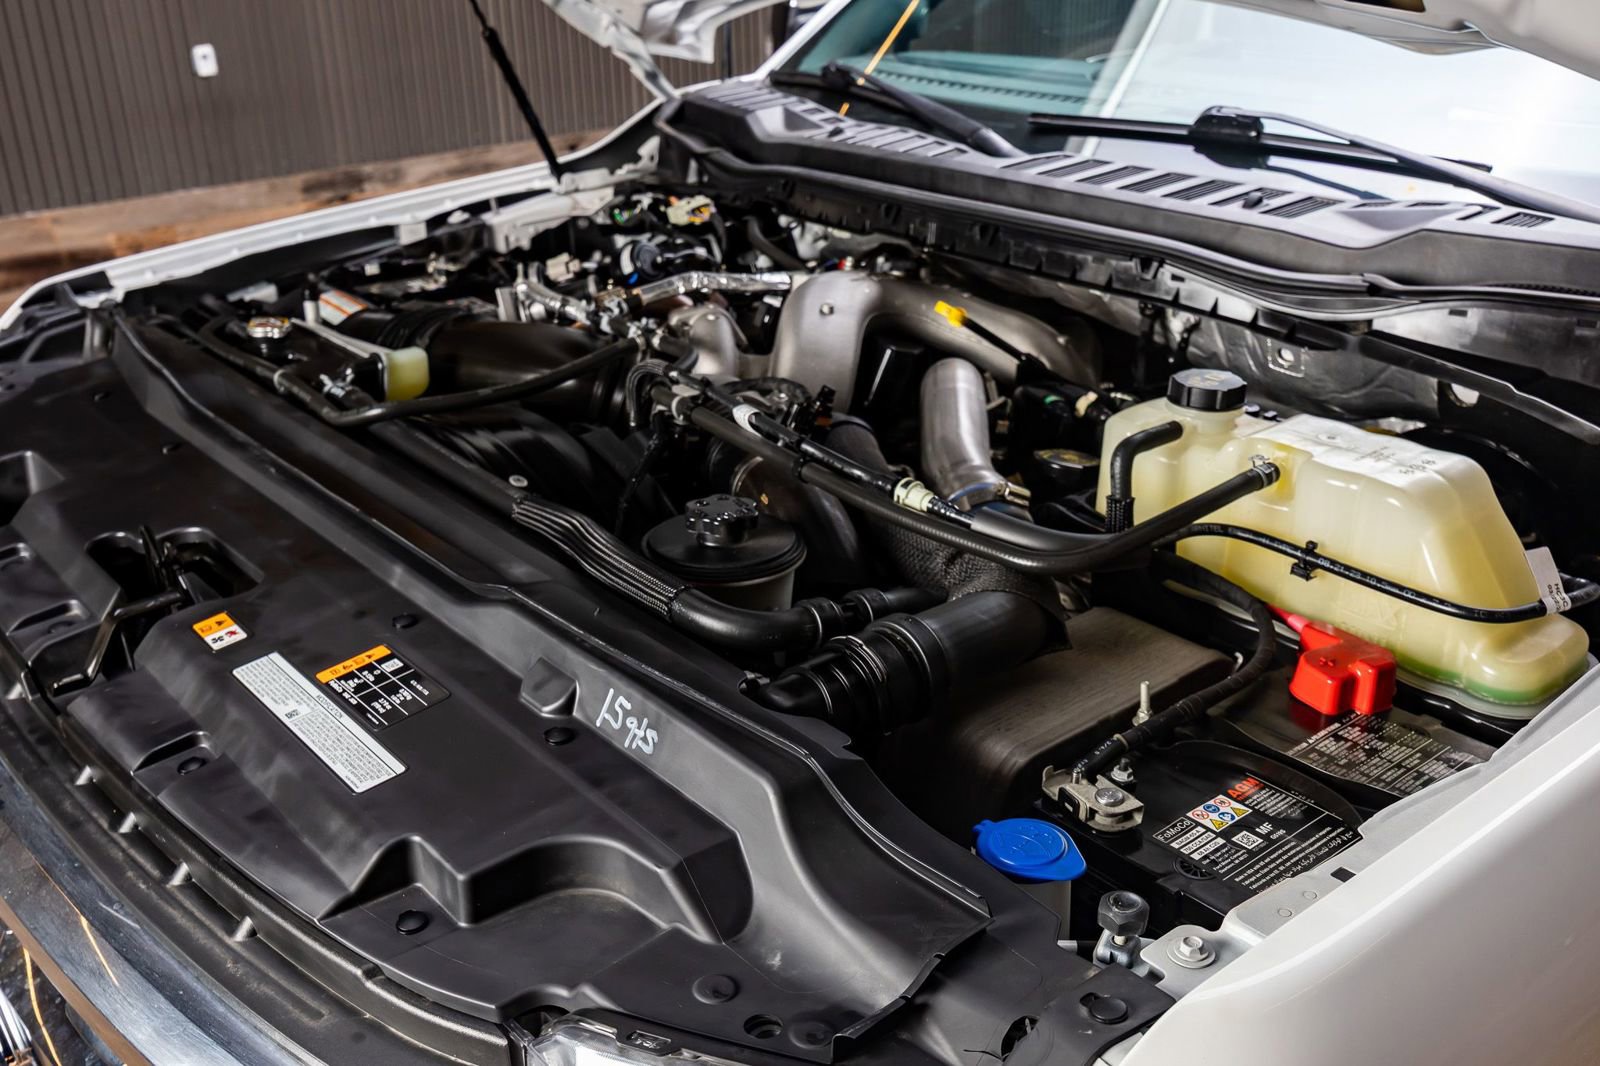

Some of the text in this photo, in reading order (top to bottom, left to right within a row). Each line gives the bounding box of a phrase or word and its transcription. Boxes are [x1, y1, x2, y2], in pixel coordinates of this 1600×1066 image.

[1226, 776, 1260, 799] AGM
[1159, 819, 1192, 842] FoMoCo
[1256, 822, 1272, 834] MF
